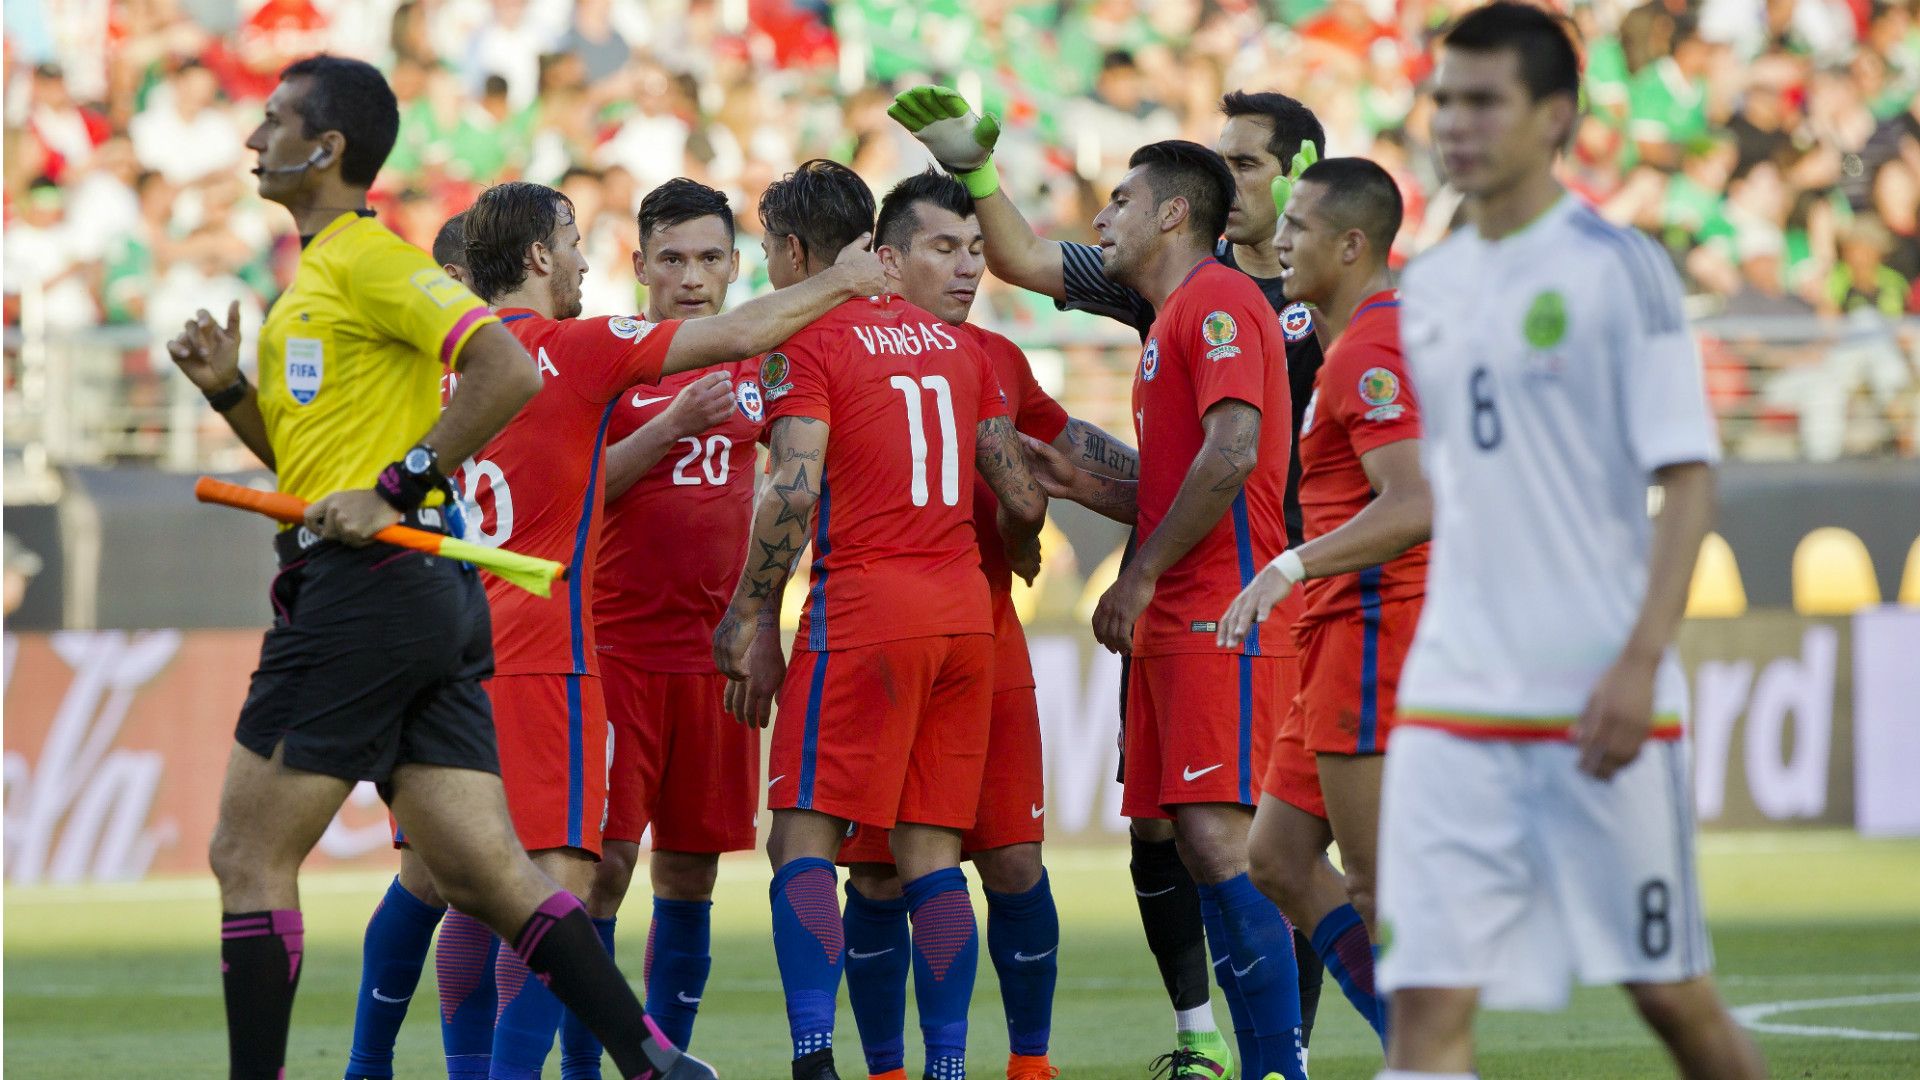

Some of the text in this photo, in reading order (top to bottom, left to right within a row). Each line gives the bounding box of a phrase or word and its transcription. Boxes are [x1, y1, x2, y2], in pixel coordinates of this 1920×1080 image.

[853, 322, 957, 355] VARGAS
[290, 363, 318, 377] FIFA
[672, 434, 733, 486] 20
[890, 375, 959, 506] 11
[1639, 879, 1672, 959] 8
